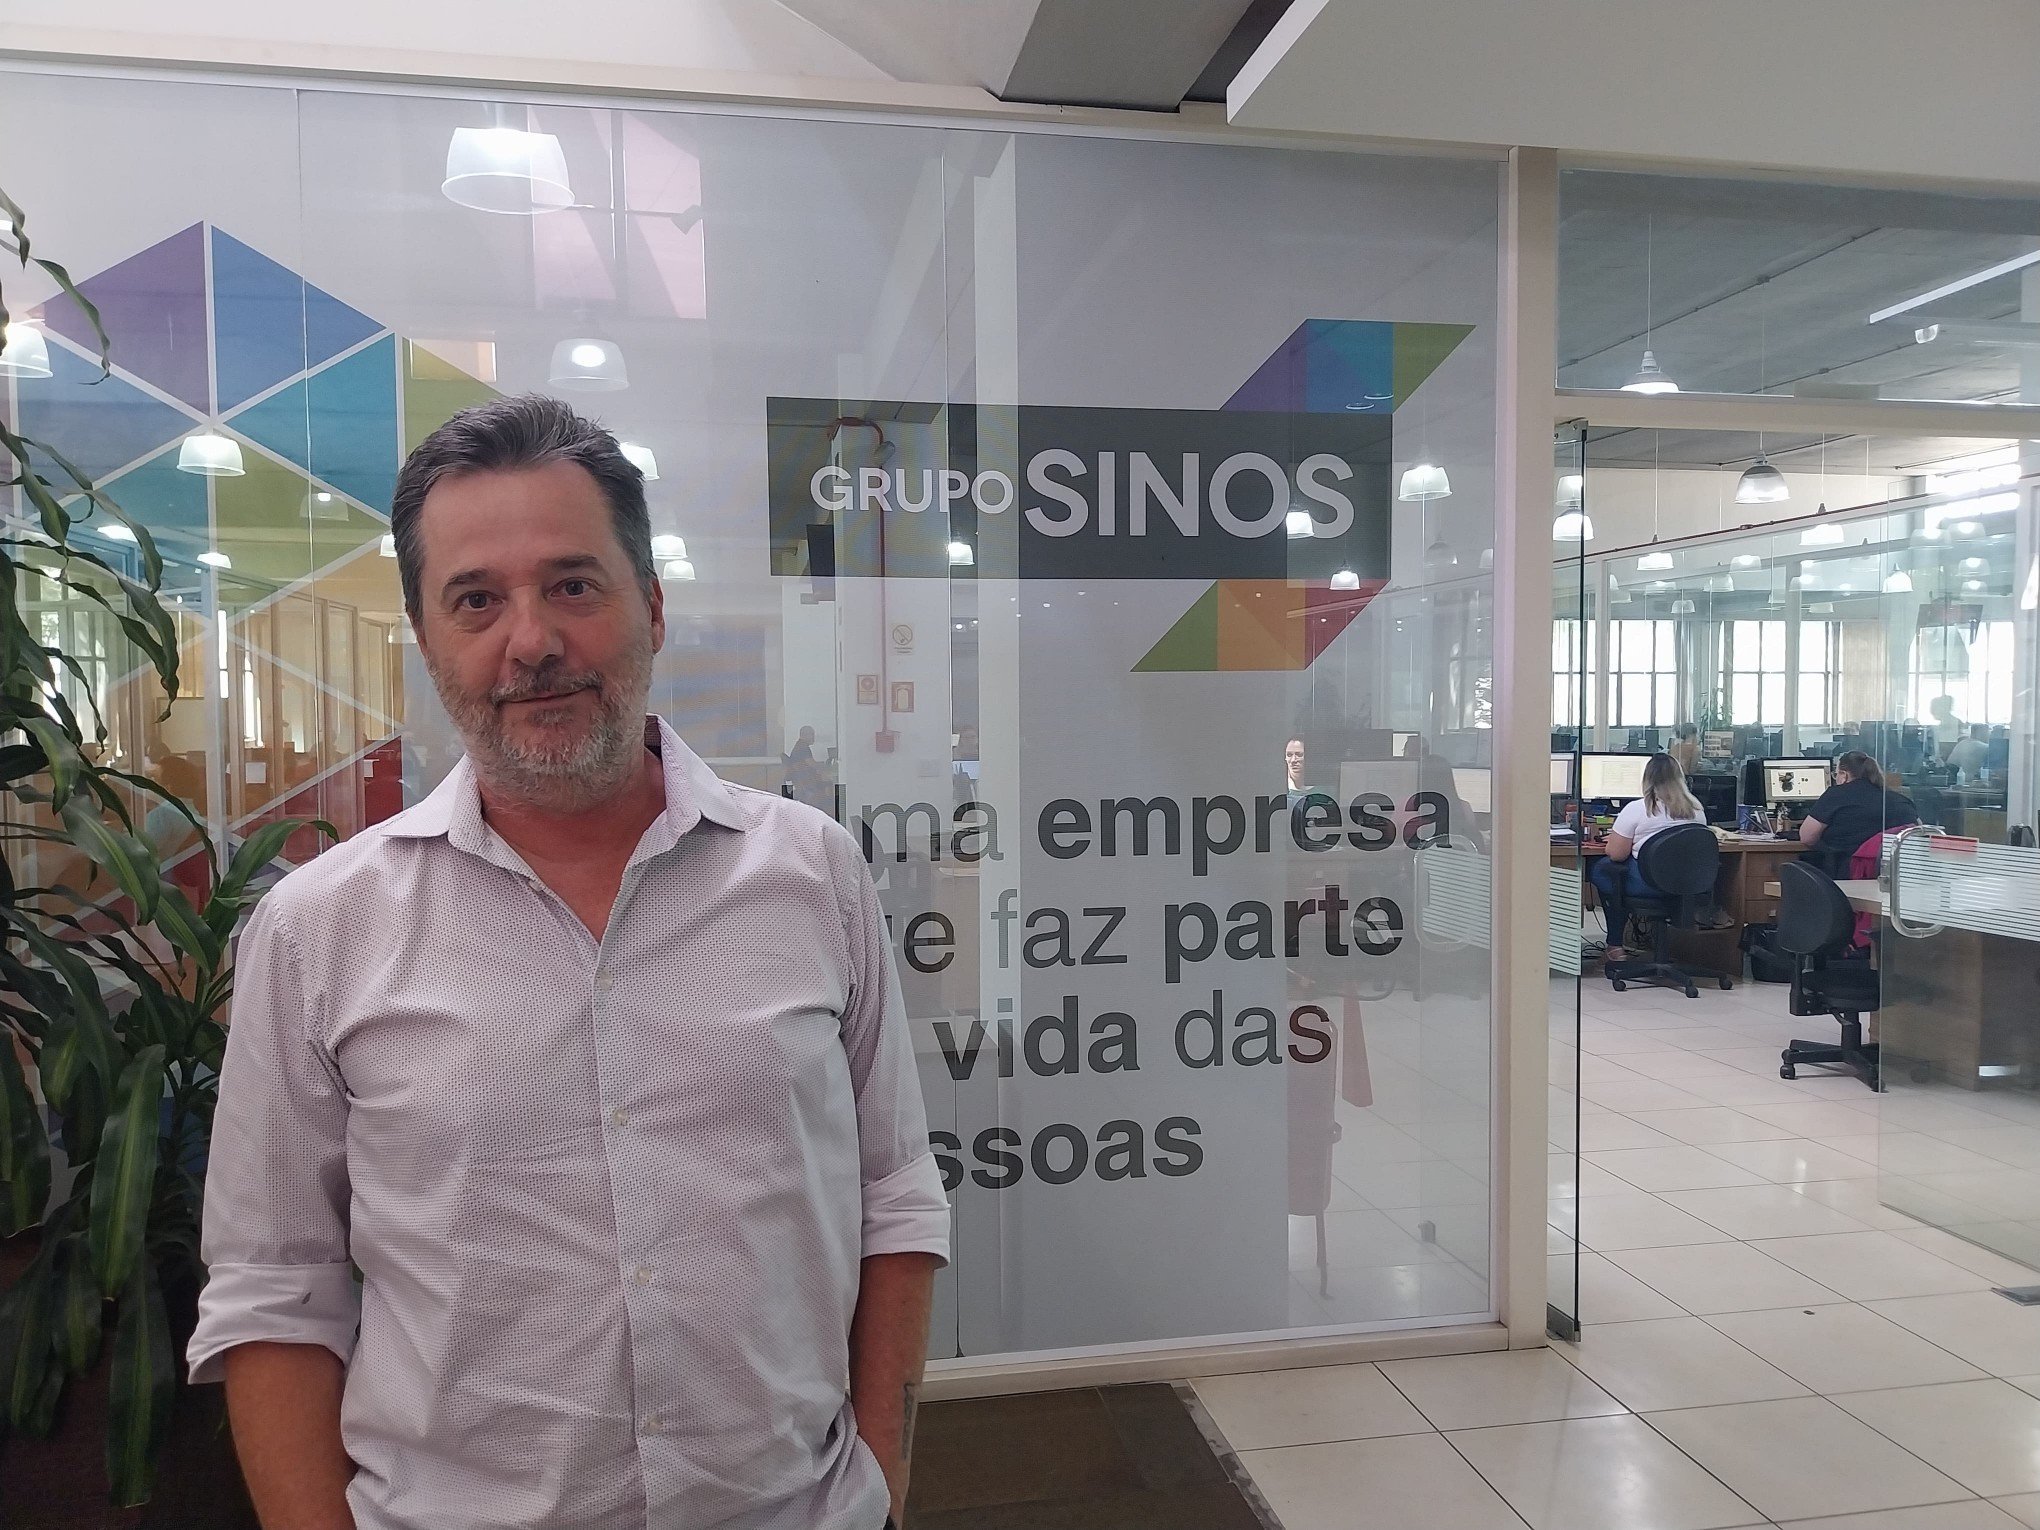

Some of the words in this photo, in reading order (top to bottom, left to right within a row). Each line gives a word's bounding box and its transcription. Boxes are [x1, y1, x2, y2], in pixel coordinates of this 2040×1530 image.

[810, 466, 1014, 514] GRUPO
[1024, 448, 1355, 538] SINOS
[1037, 791, 1452, 876] empresa
[991, 889, 1127, 969] faz
[1165, 885, 1403, 983] parte
[932, 995, 1140, 1080] vida
[1175, 989, 1332, 1069] das
[927, 1116, 1203, 1192] ssoas
